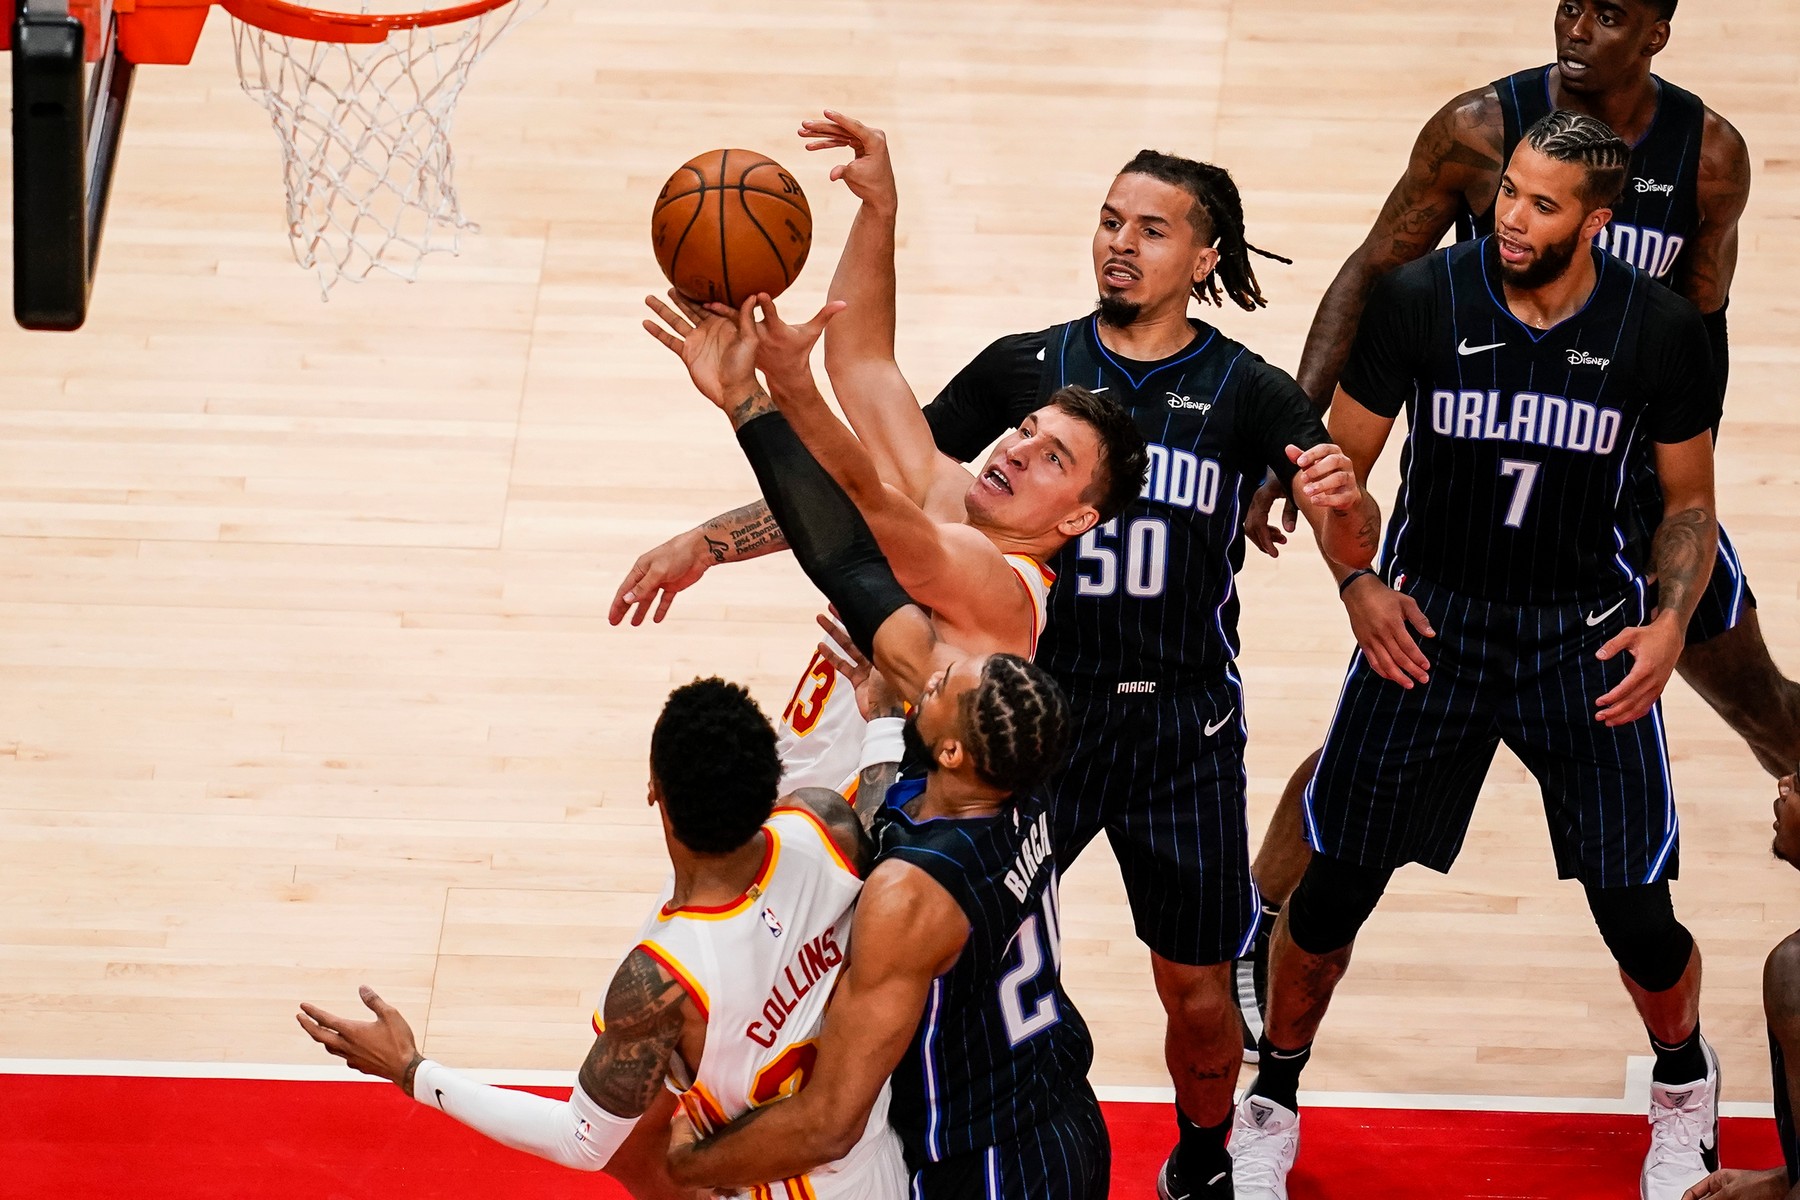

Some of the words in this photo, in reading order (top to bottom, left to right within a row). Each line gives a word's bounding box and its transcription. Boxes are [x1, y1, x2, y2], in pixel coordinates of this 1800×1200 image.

[1632, 177, 1674, 197] Disney
[1565, 349, 1610, 371] Disney
[1165, 391, 1212, 416] Disney
[1432, 389, 1623, 455] ORLANDO
[1500, 459, 1542, 529] 7
[1076, 517, 1168, 598] 50
[1117, 680, 1157, 694] MAGIC
[1003, 810, 1052, 905] BIRCH
[746, 926, 844, 1049] COLLINS
